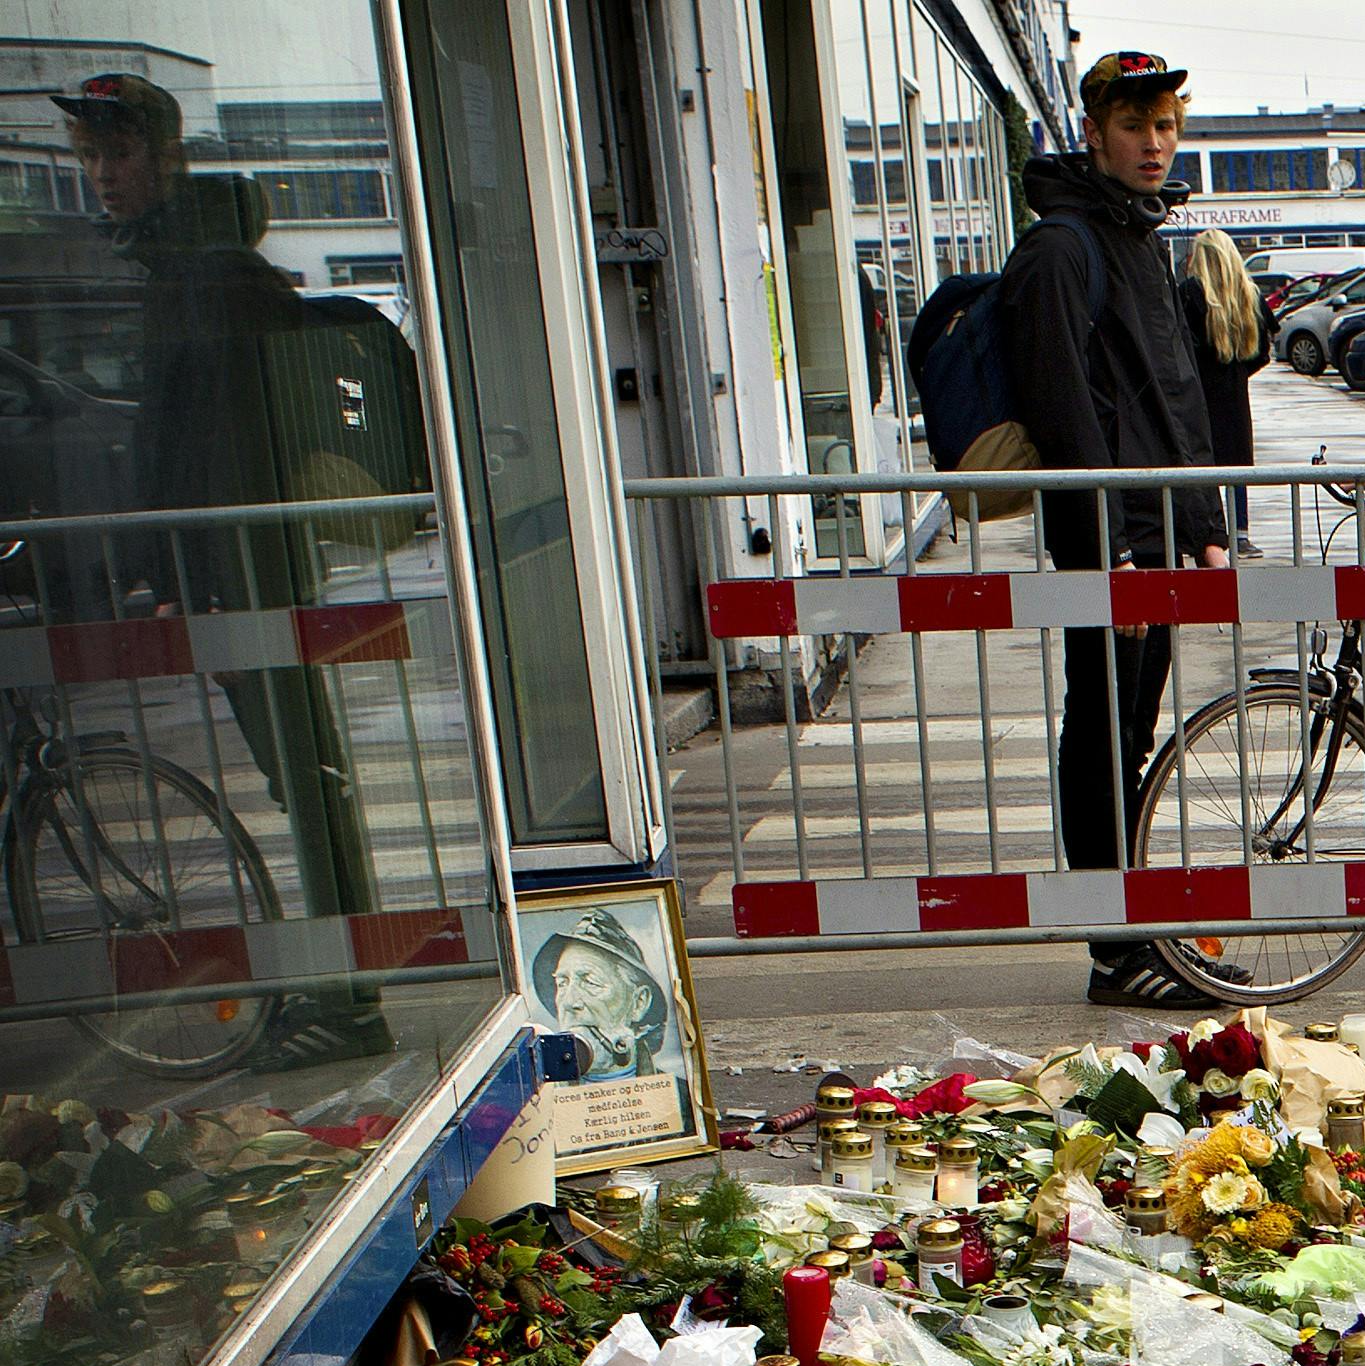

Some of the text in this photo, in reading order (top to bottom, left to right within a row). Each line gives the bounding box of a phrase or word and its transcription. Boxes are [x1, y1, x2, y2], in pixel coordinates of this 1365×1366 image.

[1123, 67, 1157, 77] MALCOLM
[554, 1079, 672, 1105] Vores tanker og dybeste
[584, 1110, 652, 1128] Kærlig hilsen
[570, 1121, 670, 1144] Os fra Bang & Jensen
